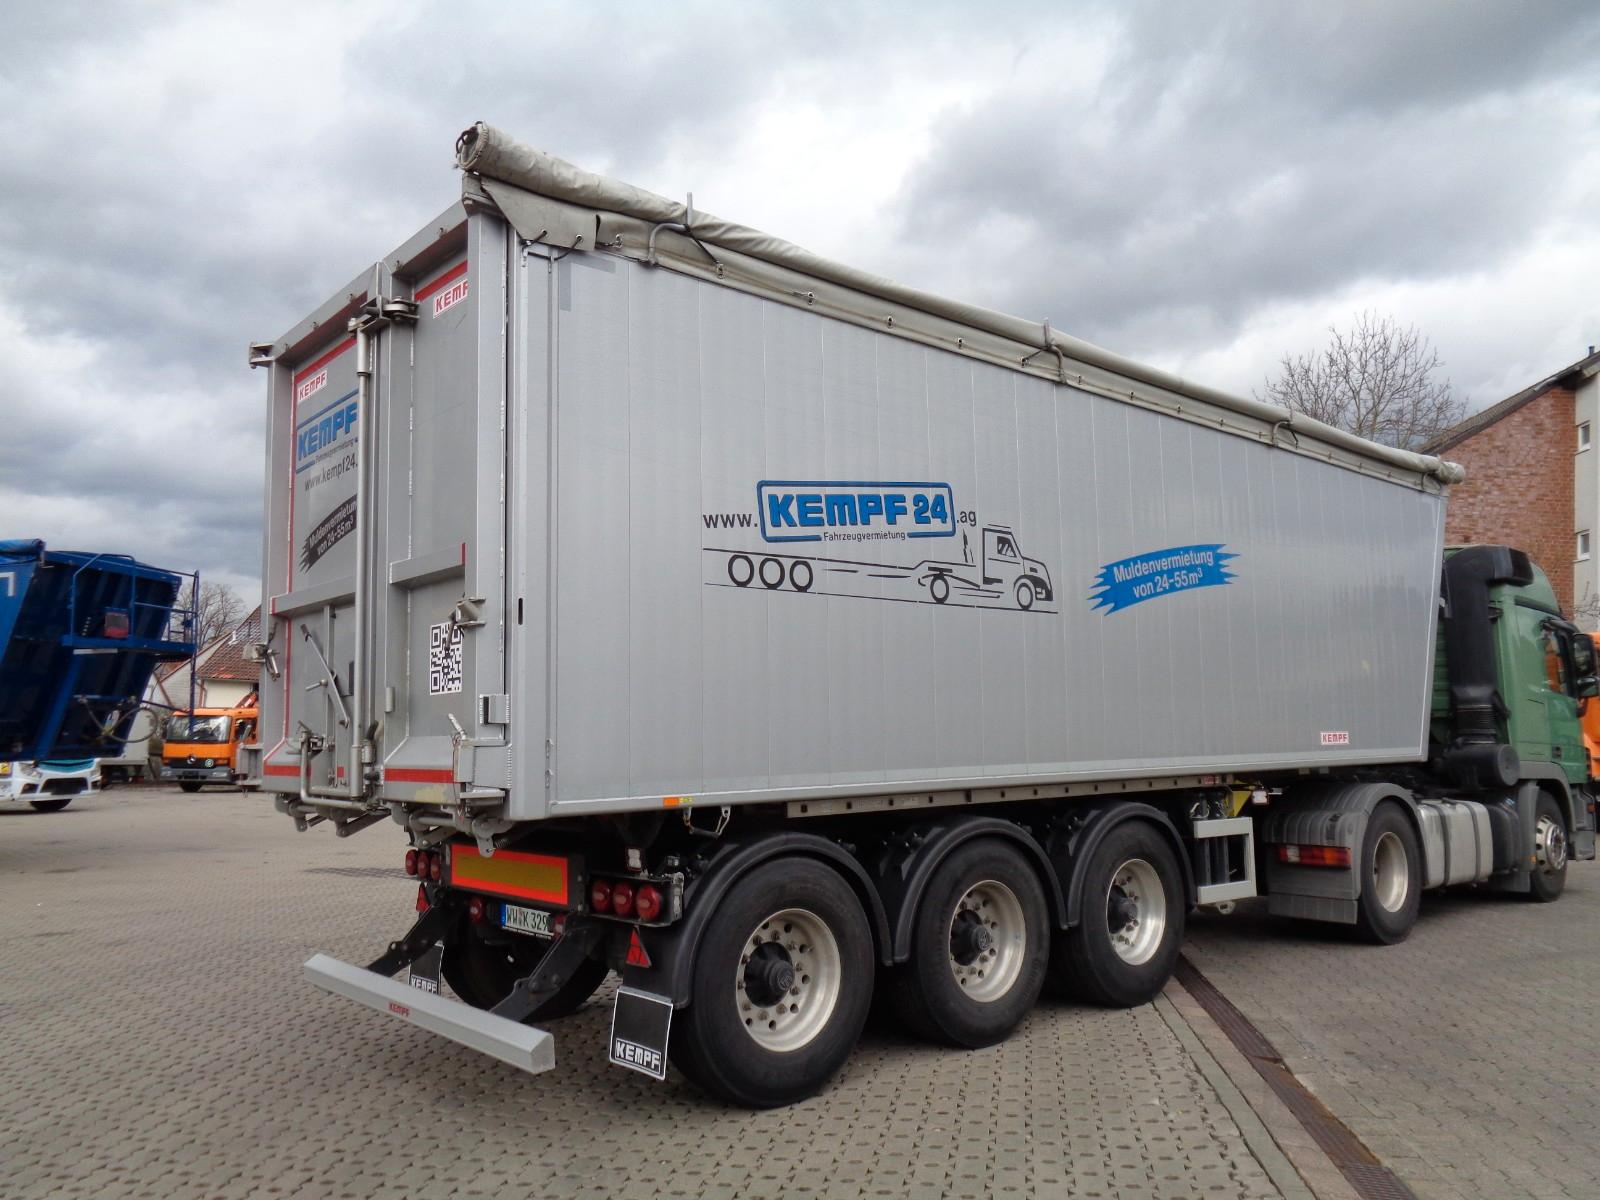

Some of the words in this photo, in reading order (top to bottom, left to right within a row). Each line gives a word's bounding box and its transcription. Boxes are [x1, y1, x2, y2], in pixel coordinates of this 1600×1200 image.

[436, 280, 469, 313] KEMP
[299, 372, 326, 400] KEMPF
[298, 401, 358, 461] KEMPF
[305, 453, 358, 492] www.kempf24.
[309, 501, 358, 549] Muldenvermietun
[703, 513, 758, 529] www.
[767, 494, 908, 528] KEMPF
[913, 494, 948, 525] 24
[823, 531, 906, 543] Fahrzeugvermietung
[1113, 550, 1213, 583] Muldenvermietung
[1133, 582, 1155, 598] von
[1322, 733, 1347, 743] KEMPF
[411, 977, 437, 995] KEMPF
[616, 1041, 660, 1069] KEMPF
